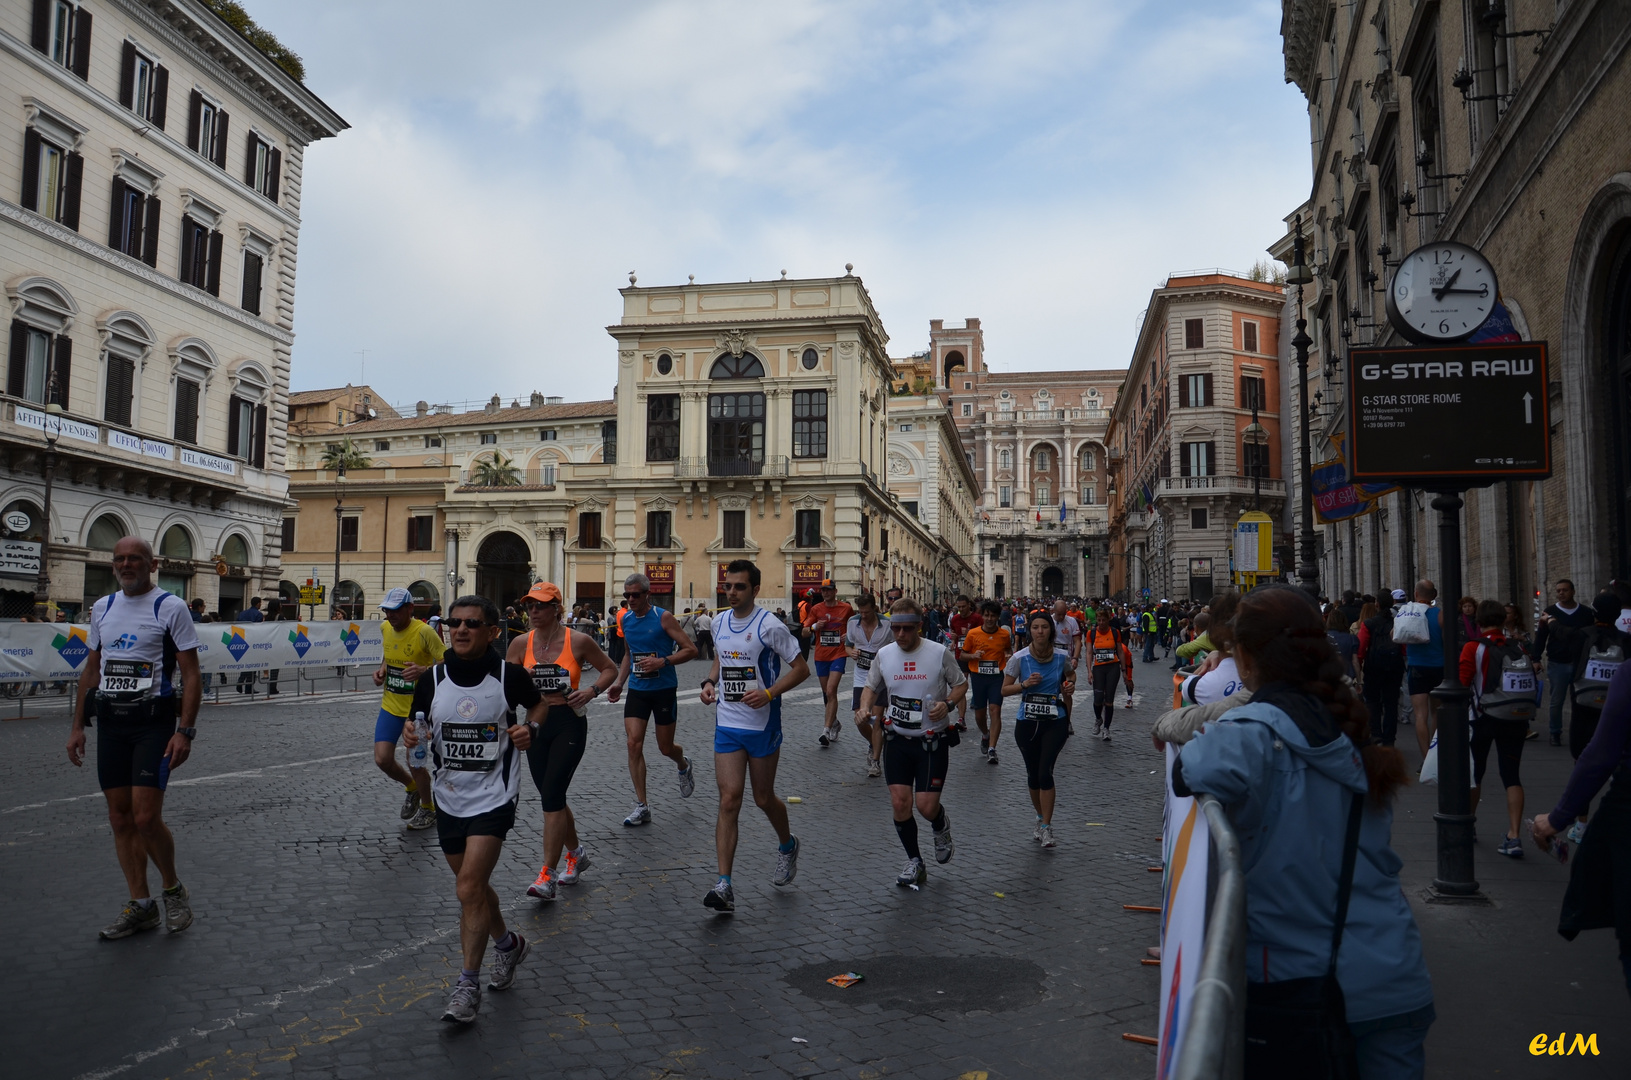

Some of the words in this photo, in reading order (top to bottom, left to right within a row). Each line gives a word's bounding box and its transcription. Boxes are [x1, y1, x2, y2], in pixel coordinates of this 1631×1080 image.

[1433, 249, 1453, 265] 12
[1398, 285, 1409, 301] 9
[1479, 283, 1489, 298] 3
[1439, 318, 1449, 334] 6
[1361, 361, 1463, 380] G-STAR
[1471, 359, 1533, 377] RAW
[1362, 395, 1397, 406] G-STAR
[1400, 394, 1430, 405] STORE
[1433, 393, 1461, 404] ROME
[116, 434, 142, 450] UFFICI
[183, 452, 198, 465] TEL.
[1316, 492, 1336, 509] TOY
[3, 647, 33, 657] energia
[252, 642, 272, 651] energia
[894, 673, 928, 681] DANMARK
[1592, 667, 1597, 677] F
[105, 677, 138, 690] 12384
[724, 681, 746, 693] 12412
[1510, 679, 1516, 689] F
[1518, 678, 1533, 689] 155
[891, 707, 910, 721] 8464
[445, 743, 484, 758] 12442
